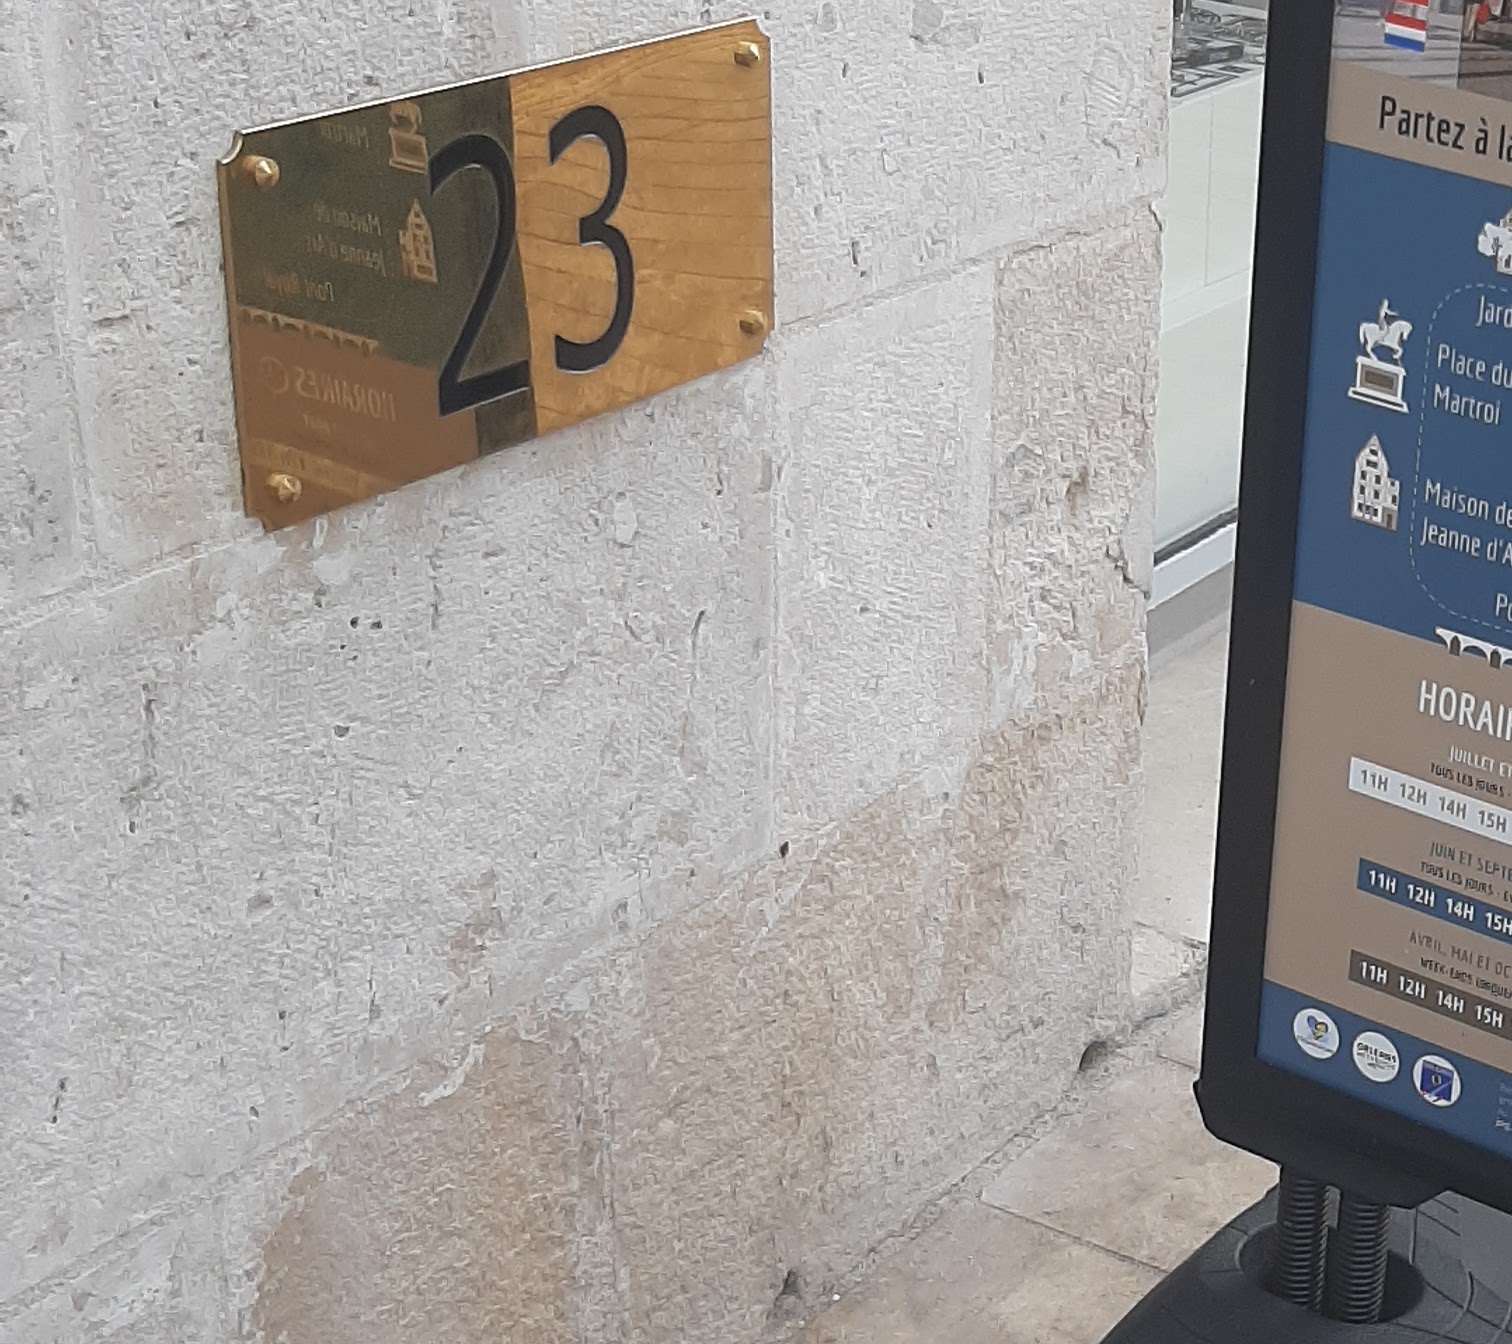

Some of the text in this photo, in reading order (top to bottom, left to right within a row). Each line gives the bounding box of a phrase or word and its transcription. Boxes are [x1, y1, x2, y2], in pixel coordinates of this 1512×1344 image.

[1379, 95, 1466, 150] Partez
[1474, 117, 1489, 156] à
[429, 104, 636, 418] 23
[1437, 343, 1486, 381] Place
[1433, 383, 1500, 425] Martroi
[1425, 478, 1489, 520] Maison
[1420, 517, 1481, 557] Jeanne
[1448, 745, 1495, 773] JUILLET
[1499, 762, 1512, 778] ET
[1360, 769, 1388, 792] 11H
[1399, 783, 1427, 806] 12H
[1438, 796, 1467, 820] 14H
[1478, 809, 1507, 834] 15H
[1429, 841, 1456, 862] JUIN
[1459, 850, 1473, 867] ET
[1369, 870, 1396, 894] 11H
[1407, 884, 1435, 908] 12H
[1446, 898, 1474, 922] 14H
[1362, 961, 1387, 984] 11H
[1399, 975, 1426, 999] 12H
[1438, 990, 1464, 1013] 14H
[1476, 1004, 1503, 1028] 15H
